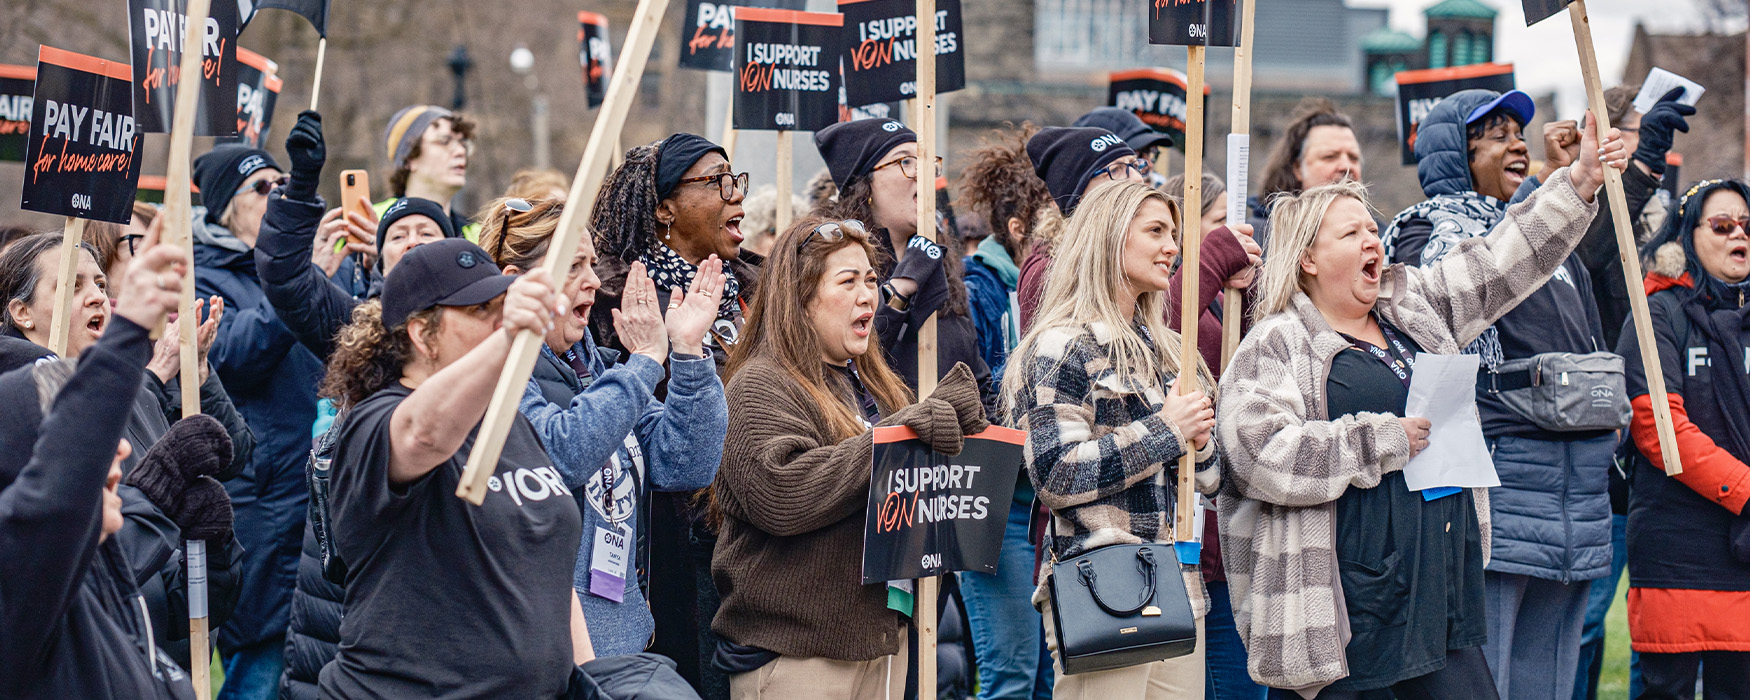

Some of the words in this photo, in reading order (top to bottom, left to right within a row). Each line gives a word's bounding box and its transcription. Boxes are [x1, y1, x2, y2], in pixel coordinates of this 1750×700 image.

[144, 8, 176, 52] PAY
[689, 23, 717, 55] for
[859, 22, 866, 42] I
[1188, 23, 1207, 38] ONA
[747, 42, 753, 63] I
[754, 42, 822, 66] SUPPORT
[851, 36, 895, 71] VON
[142, 45, 165, 104] for
[739, 60, 776, 92] VON
[773, 69, 830, 92] NURSES
[43, 99, 89, 142] PAY
[90, 109, 136, 152] FAIR
[775, 112, 795, 126] ONA
[33, 132, 57, 185] for
[72, 193, 92, 211] ONA
[1391, 361, 1407, 380] ONA
[1591, 389, 1614, 398] ONA
[603, 467, 613, 490] ONA
[887, 470, 893, 494] I
[894, 465, 981, 494] SUPPORT
[877, 490, 919, 534] VON
[918, 495, 990, 524] NURSES
[604, 532, 624, 550] ONA
[921, 552, 942, 569] ONA
